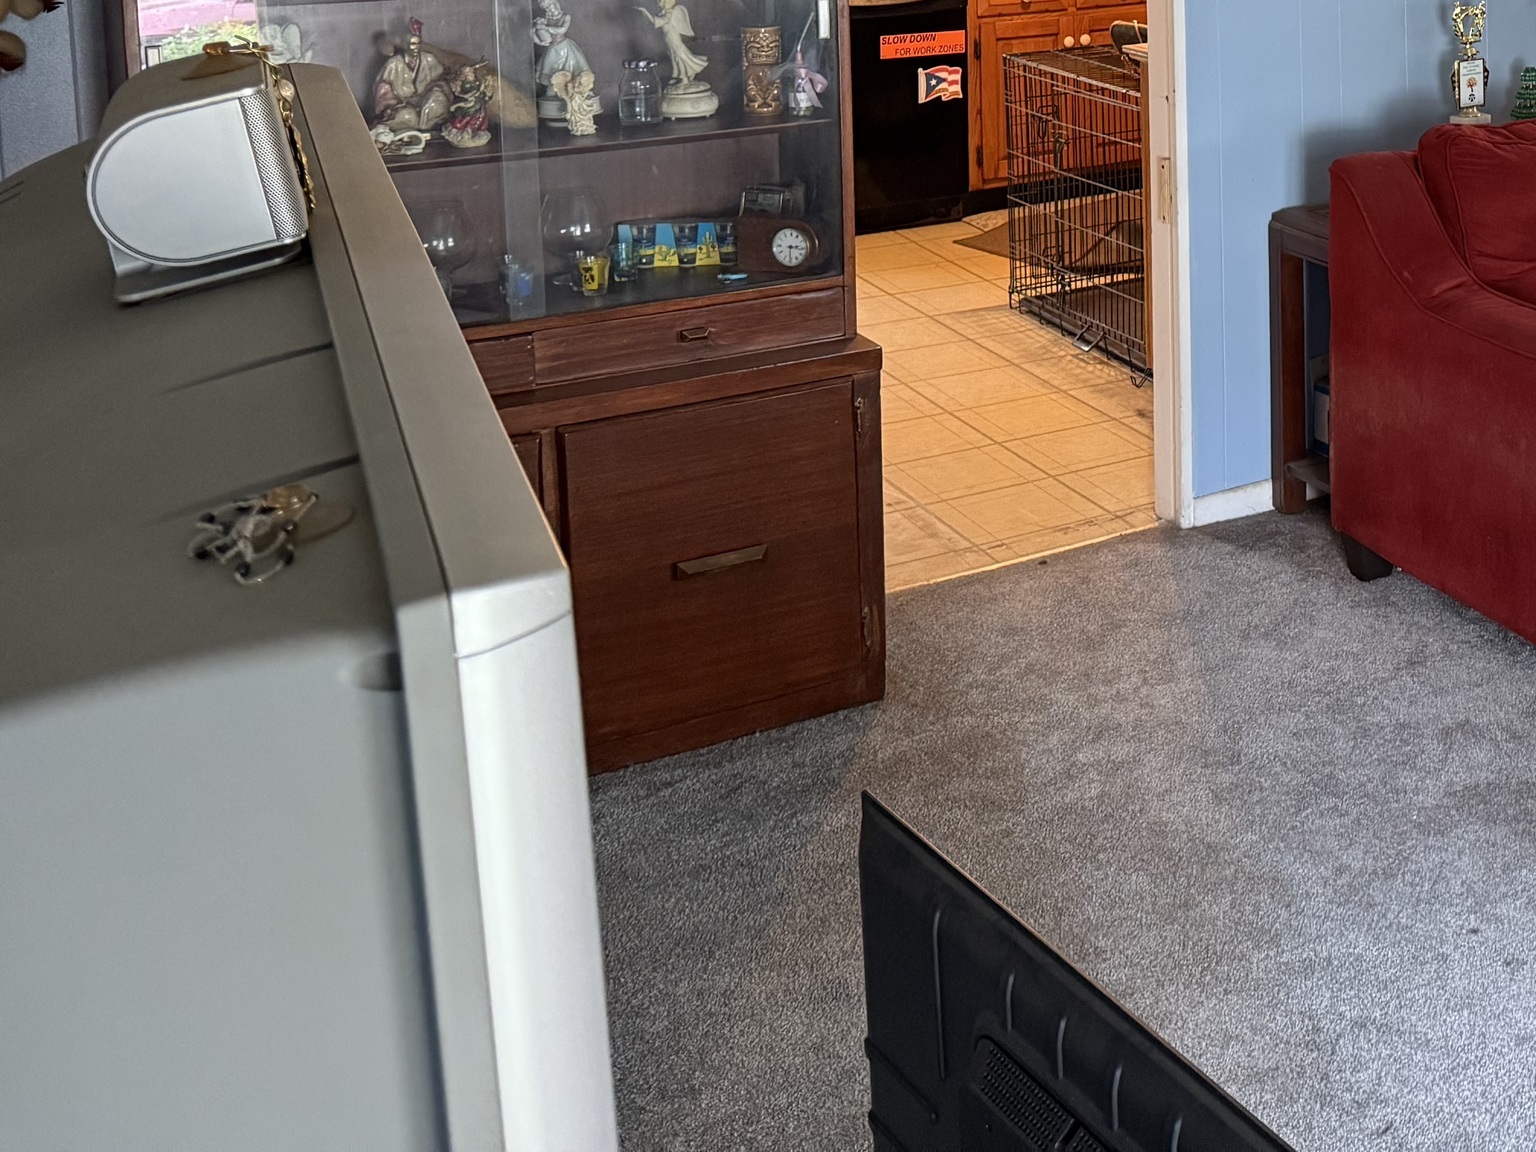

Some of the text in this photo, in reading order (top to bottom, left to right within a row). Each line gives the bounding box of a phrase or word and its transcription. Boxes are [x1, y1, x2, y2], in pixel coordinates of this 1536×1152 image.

[881, 33, 937, 46] SLOW DOWN
[894, 43, 964, 57] FOR WORK ZONES
